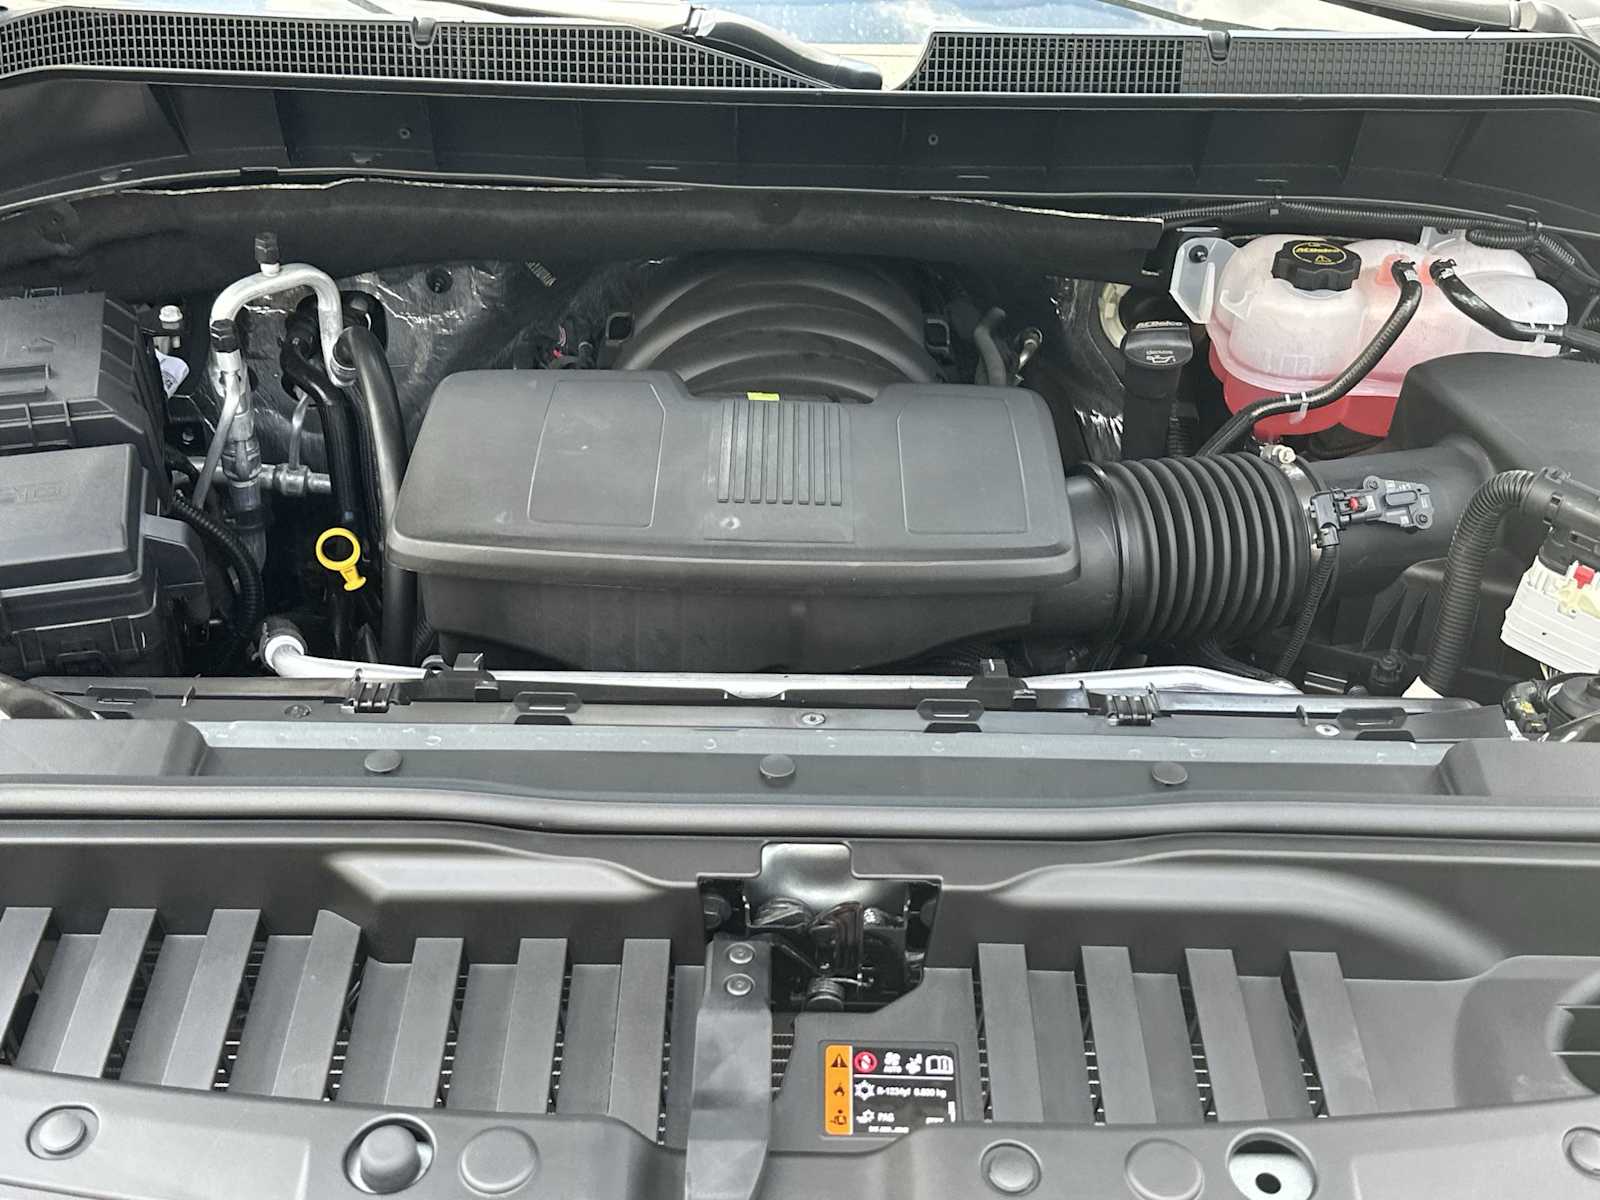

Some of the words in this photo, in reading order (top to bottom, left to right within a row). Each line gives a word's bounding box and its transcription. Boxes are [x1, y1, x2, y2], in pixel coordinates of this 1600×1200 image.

[1136, 320, 1183, 329] ACDelco
[936, 1088, 947, 1099] kg
[877, 1112, 895, 1122] PAG
